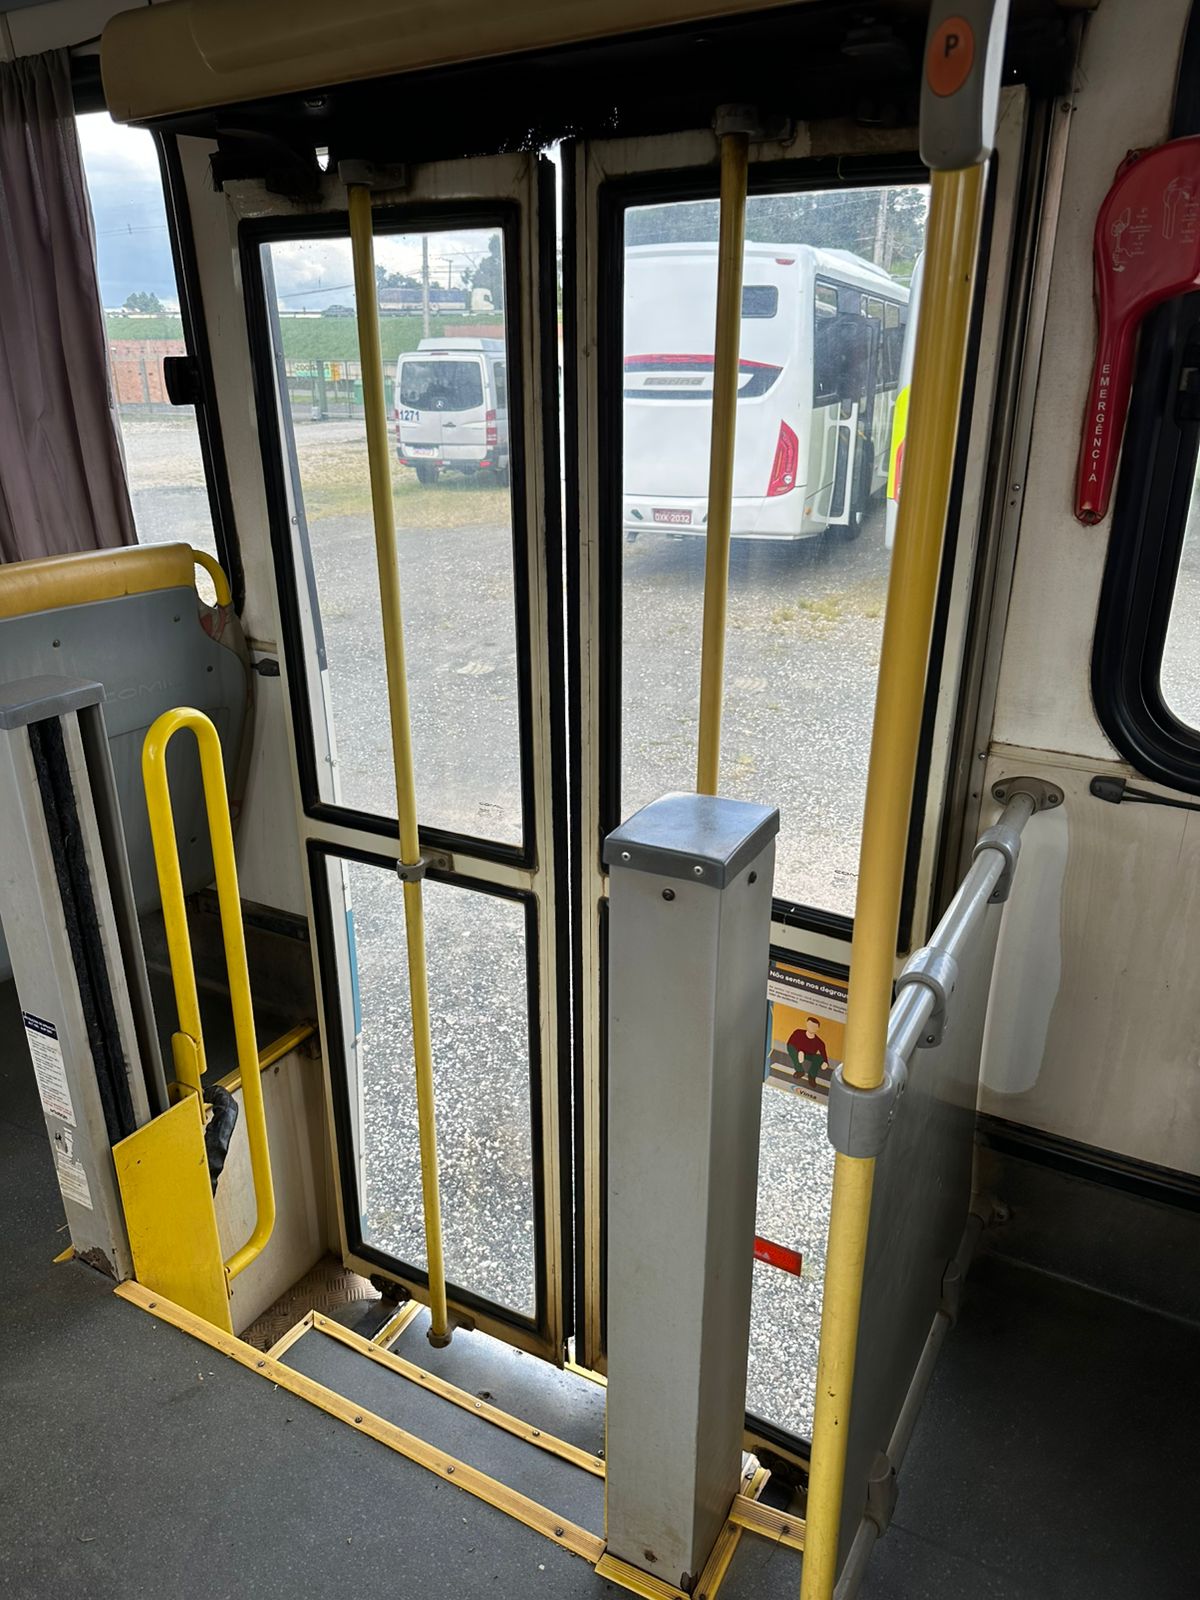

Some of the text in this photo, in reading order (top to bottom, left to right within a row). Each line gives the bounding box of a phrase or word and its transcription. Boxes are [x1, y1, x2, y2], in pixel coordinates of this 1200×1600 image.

[944, 34, 959, 59] P
[400, 410, 420, 421] 1271
[1088, 364, 1111, 482] EMERGÊNCIA
[769, 970, 784, 980] Não
[785, 975, 805, 986] sente
[805, 981, 819, 991] nos
